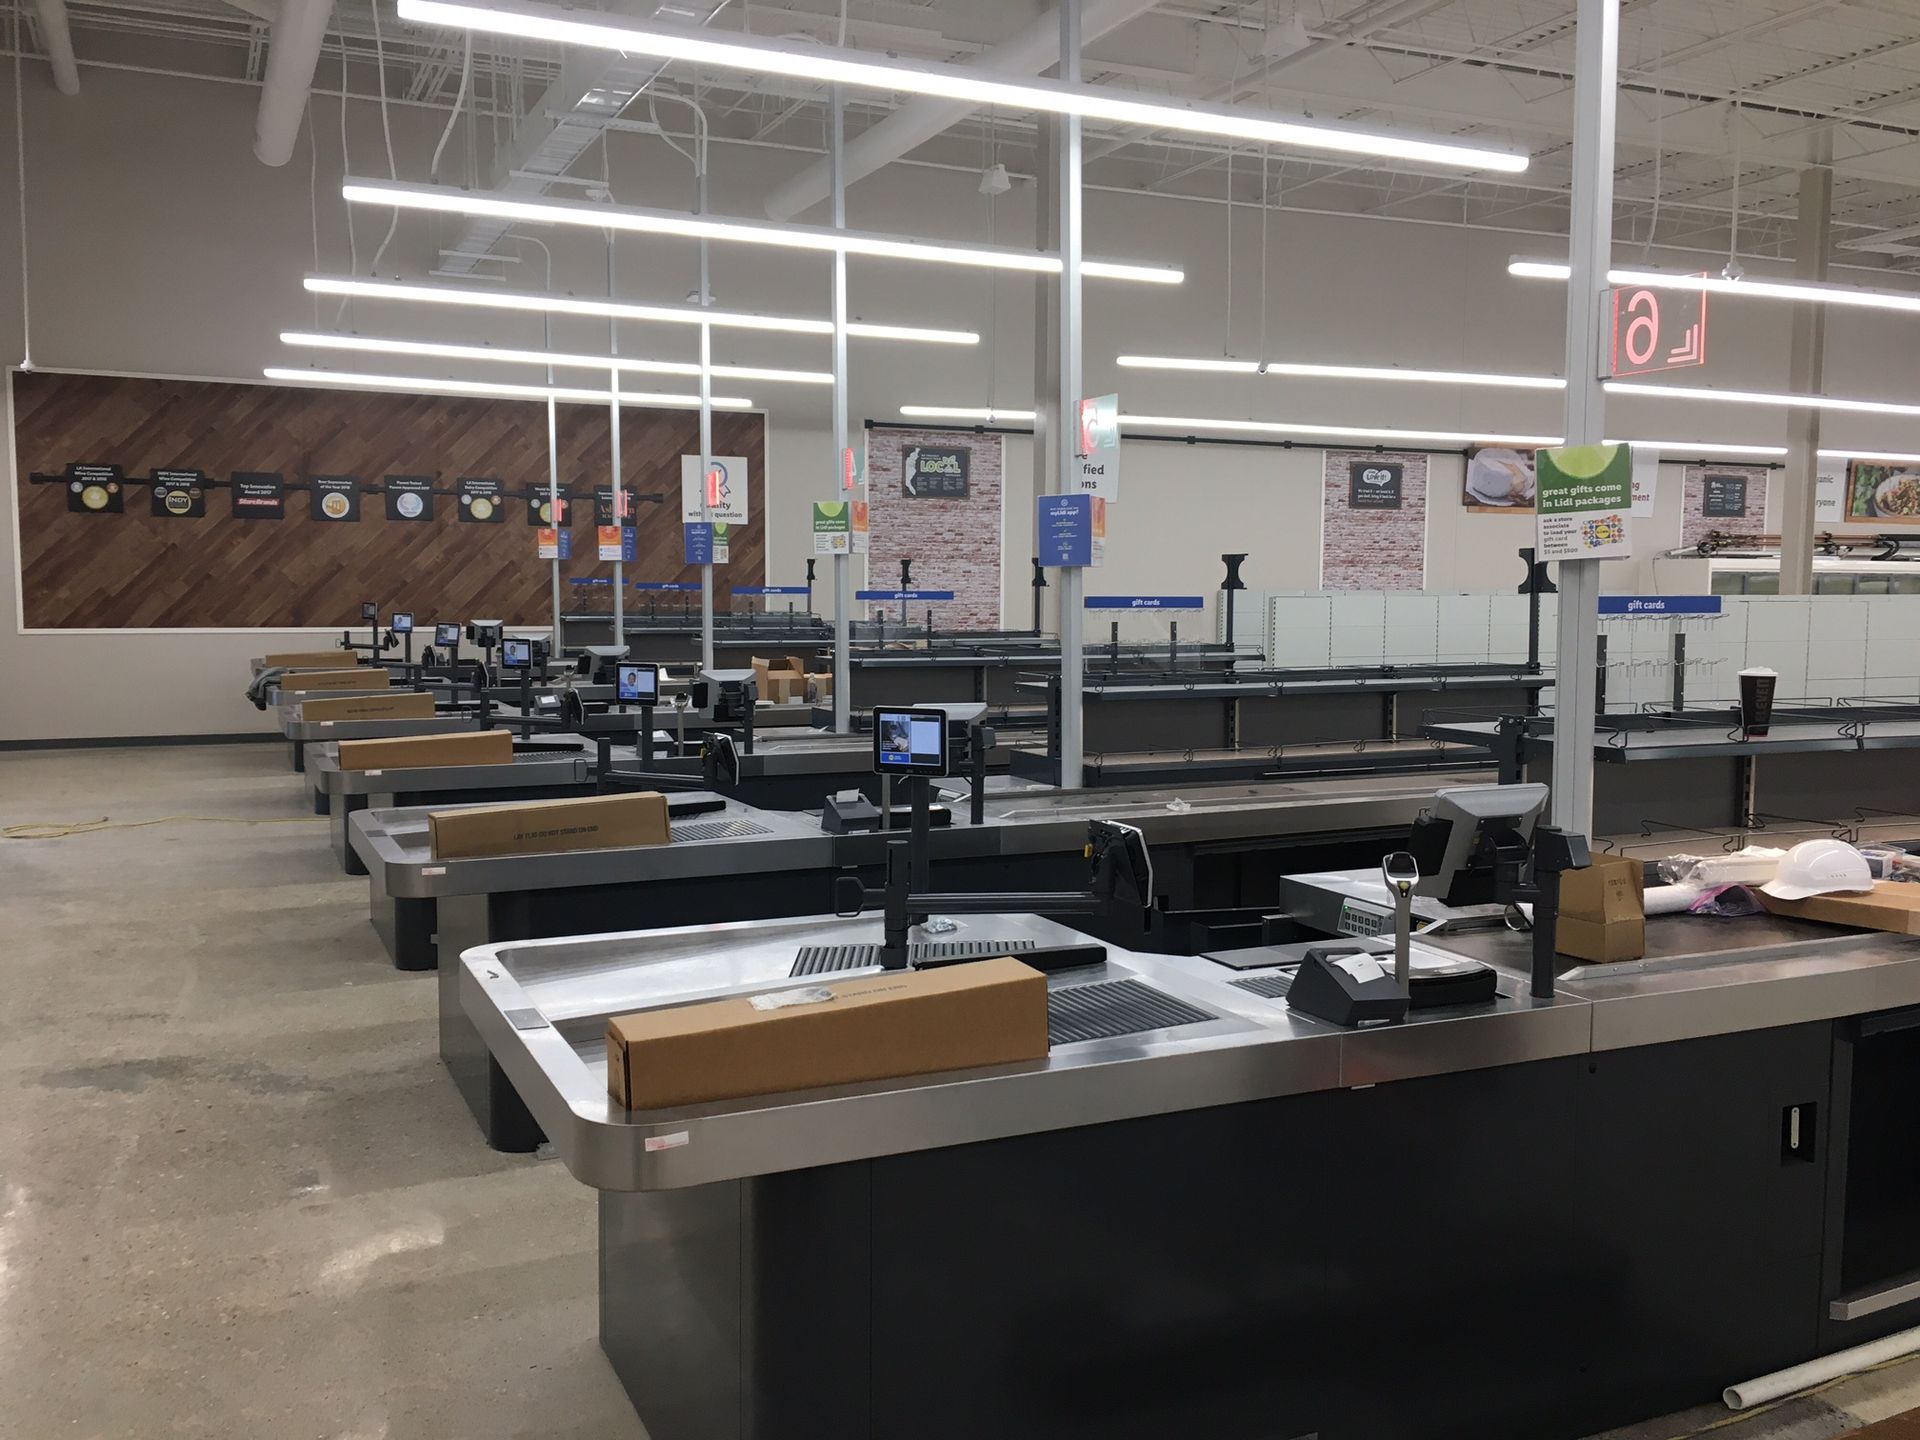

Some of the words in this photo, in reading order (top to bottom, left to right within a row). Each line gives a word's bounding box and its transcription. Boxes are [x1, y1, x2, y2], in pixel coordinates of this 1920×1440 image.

[1082, 464, 1104, 475] fied
[1542, 488, 1568, 498] great
[1570, 485, 1593, 495] gifts
[1542, 500, 1552, 508] in
[1554, 498, 1573, 507] Lidl
[1574, 496, 1622, 507] packages
[714, 512, 742, 520] question
[1132, 599, 1143, 607] gift
[1628, 600, 1642, 611] gift
[1644, 600, 1665, 609] cards
[560, 827, 577, 835] STAND
